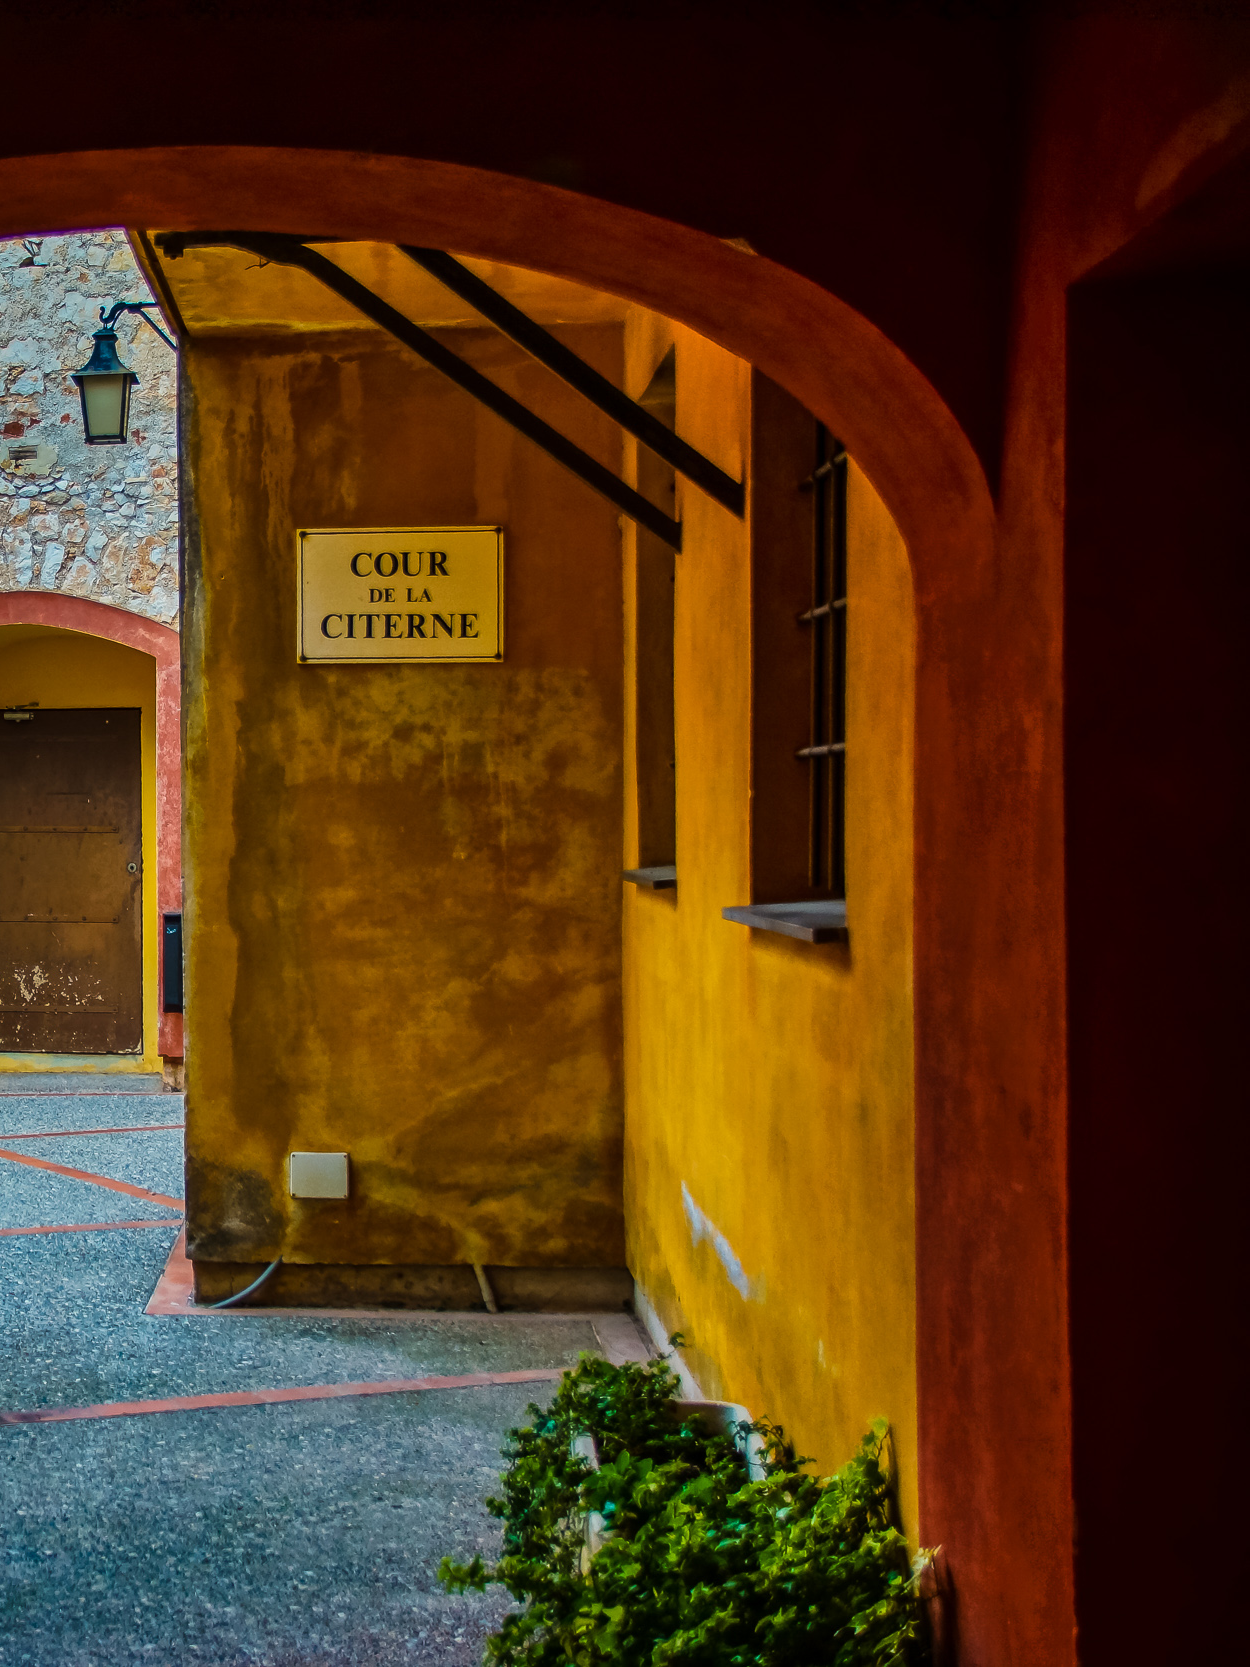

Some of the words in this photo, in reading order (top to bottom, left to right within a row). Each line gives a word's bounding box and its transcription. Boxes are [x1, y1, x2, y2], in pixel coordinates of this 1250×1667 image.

[350, 551, 450, 578] COUR
[368, 588, 396, 603] DE
[406, 587, 432, 603] LA
[320, 613, 479, 639] CITERNE
